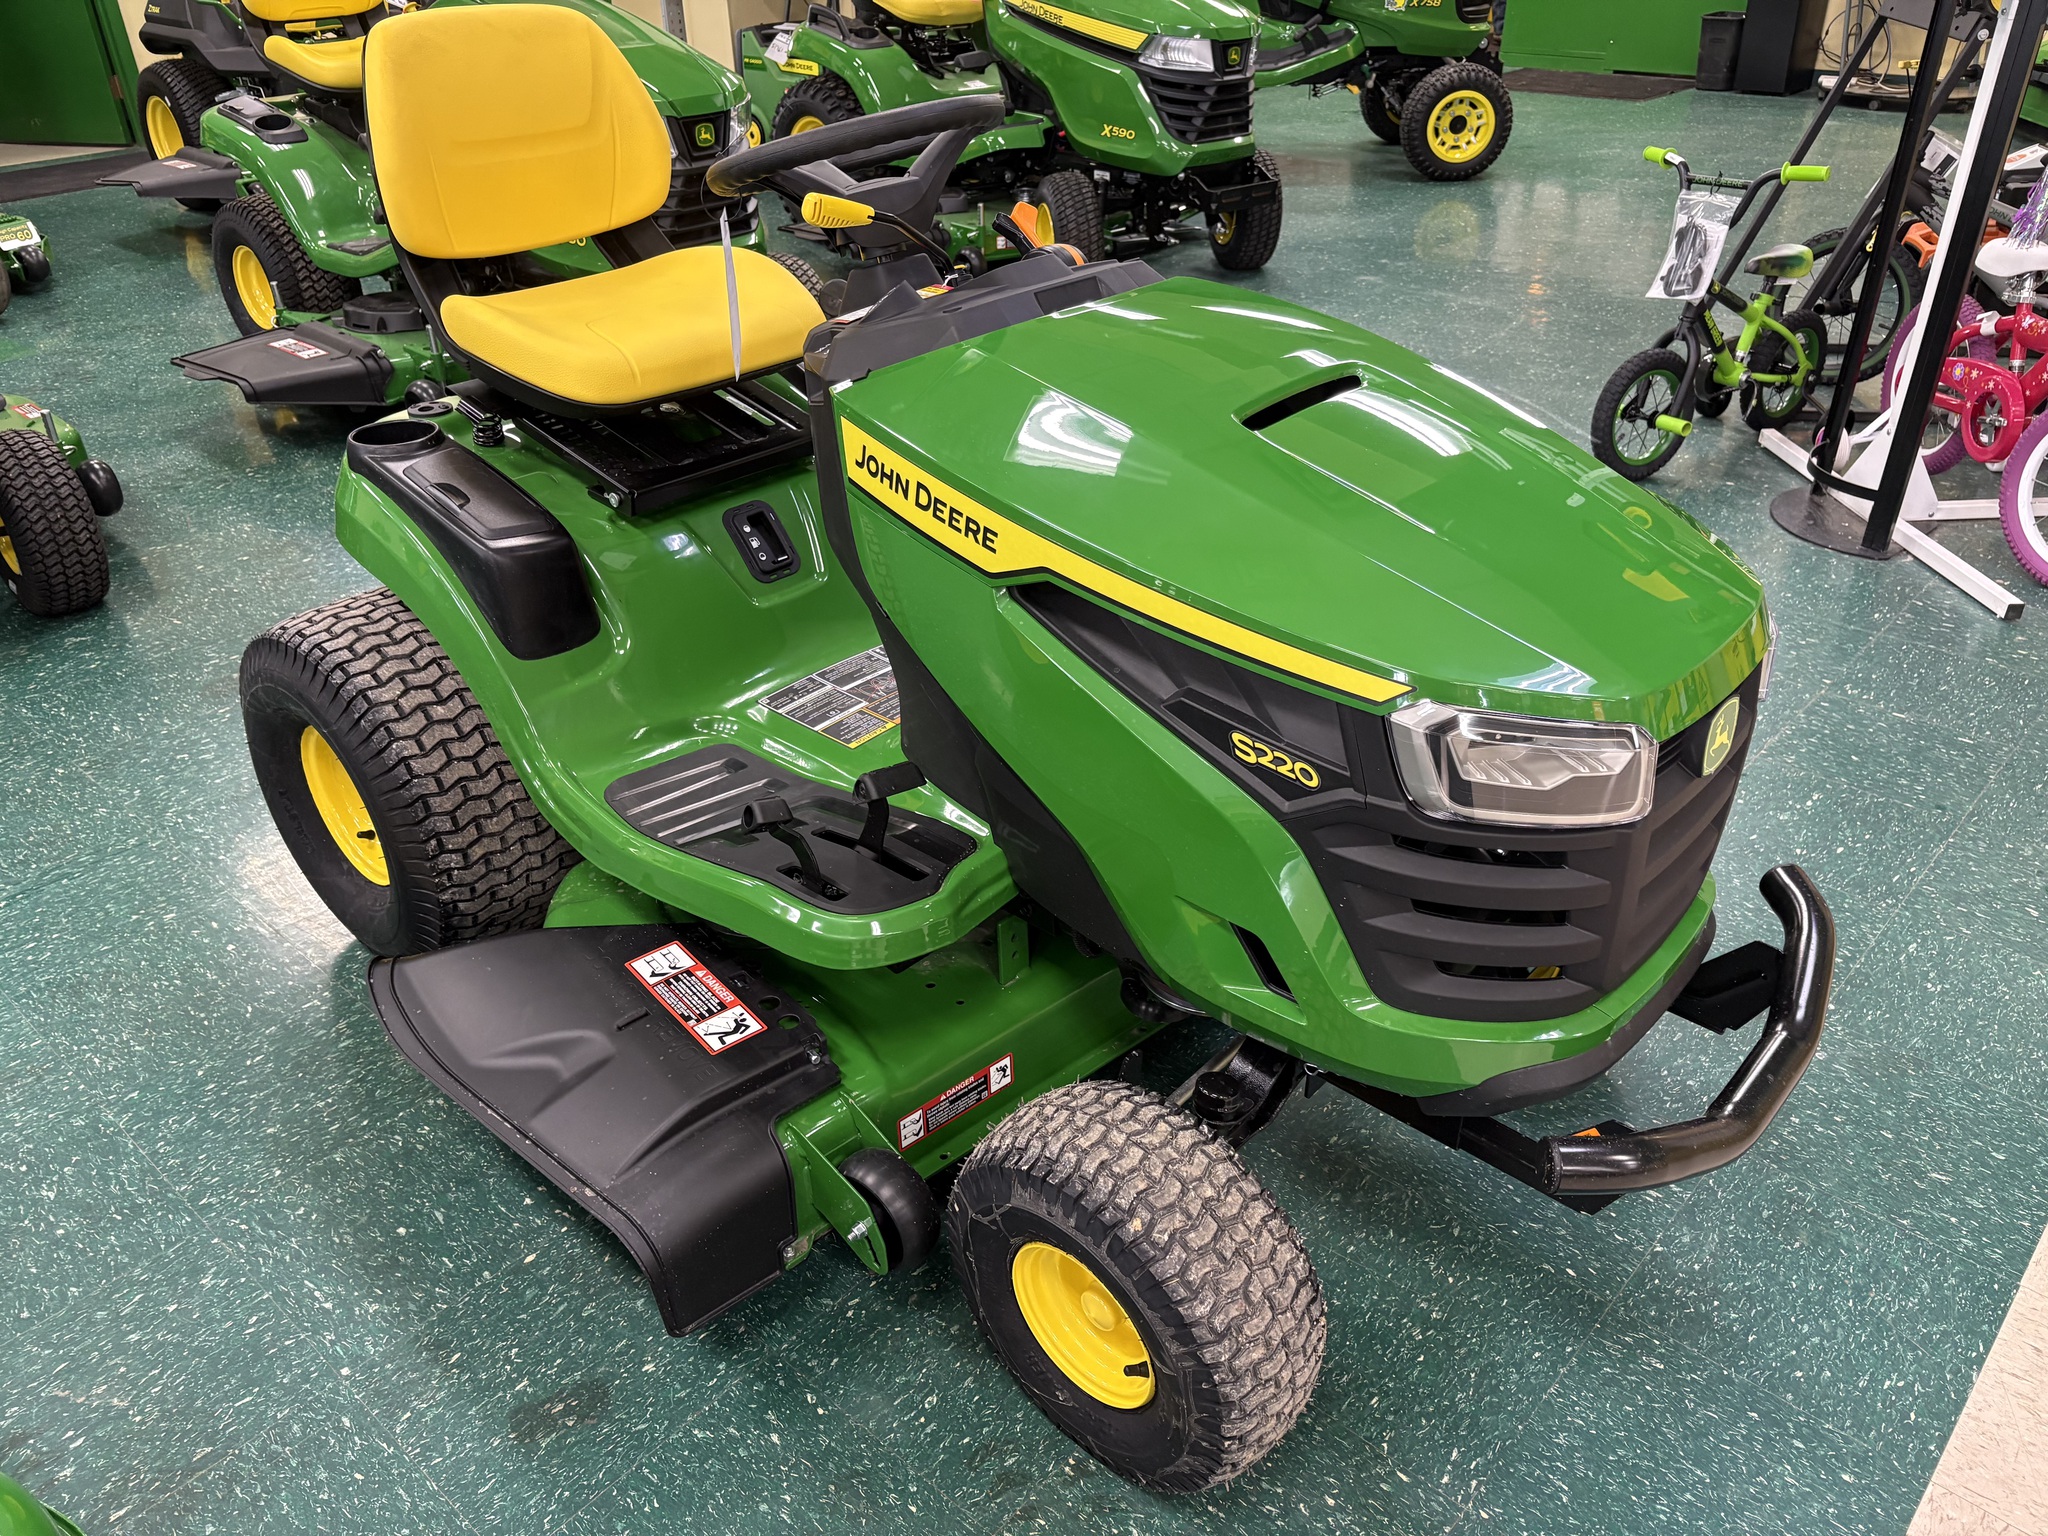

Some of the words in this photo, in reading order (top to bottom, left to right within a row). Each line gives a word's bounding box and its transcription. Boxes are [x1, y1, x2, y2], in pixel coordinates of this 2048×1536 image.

[1020, 1, 1039, 17] JOHN
[1039, 6, 1064, 24] DEERE
[1100, 124, 1135, 140] X590
[1716, 178, 1744, 187] DEERE
[17, 229, 32, 241] 60
[855, 444, 910, 502] JOHN
[914, 480, 999, 555] DEERE
[1231, 732, 1319, 788] S220
[703, 975, 734, 1003] DANGER
[947, 1076, 974, 1097] DANGER
